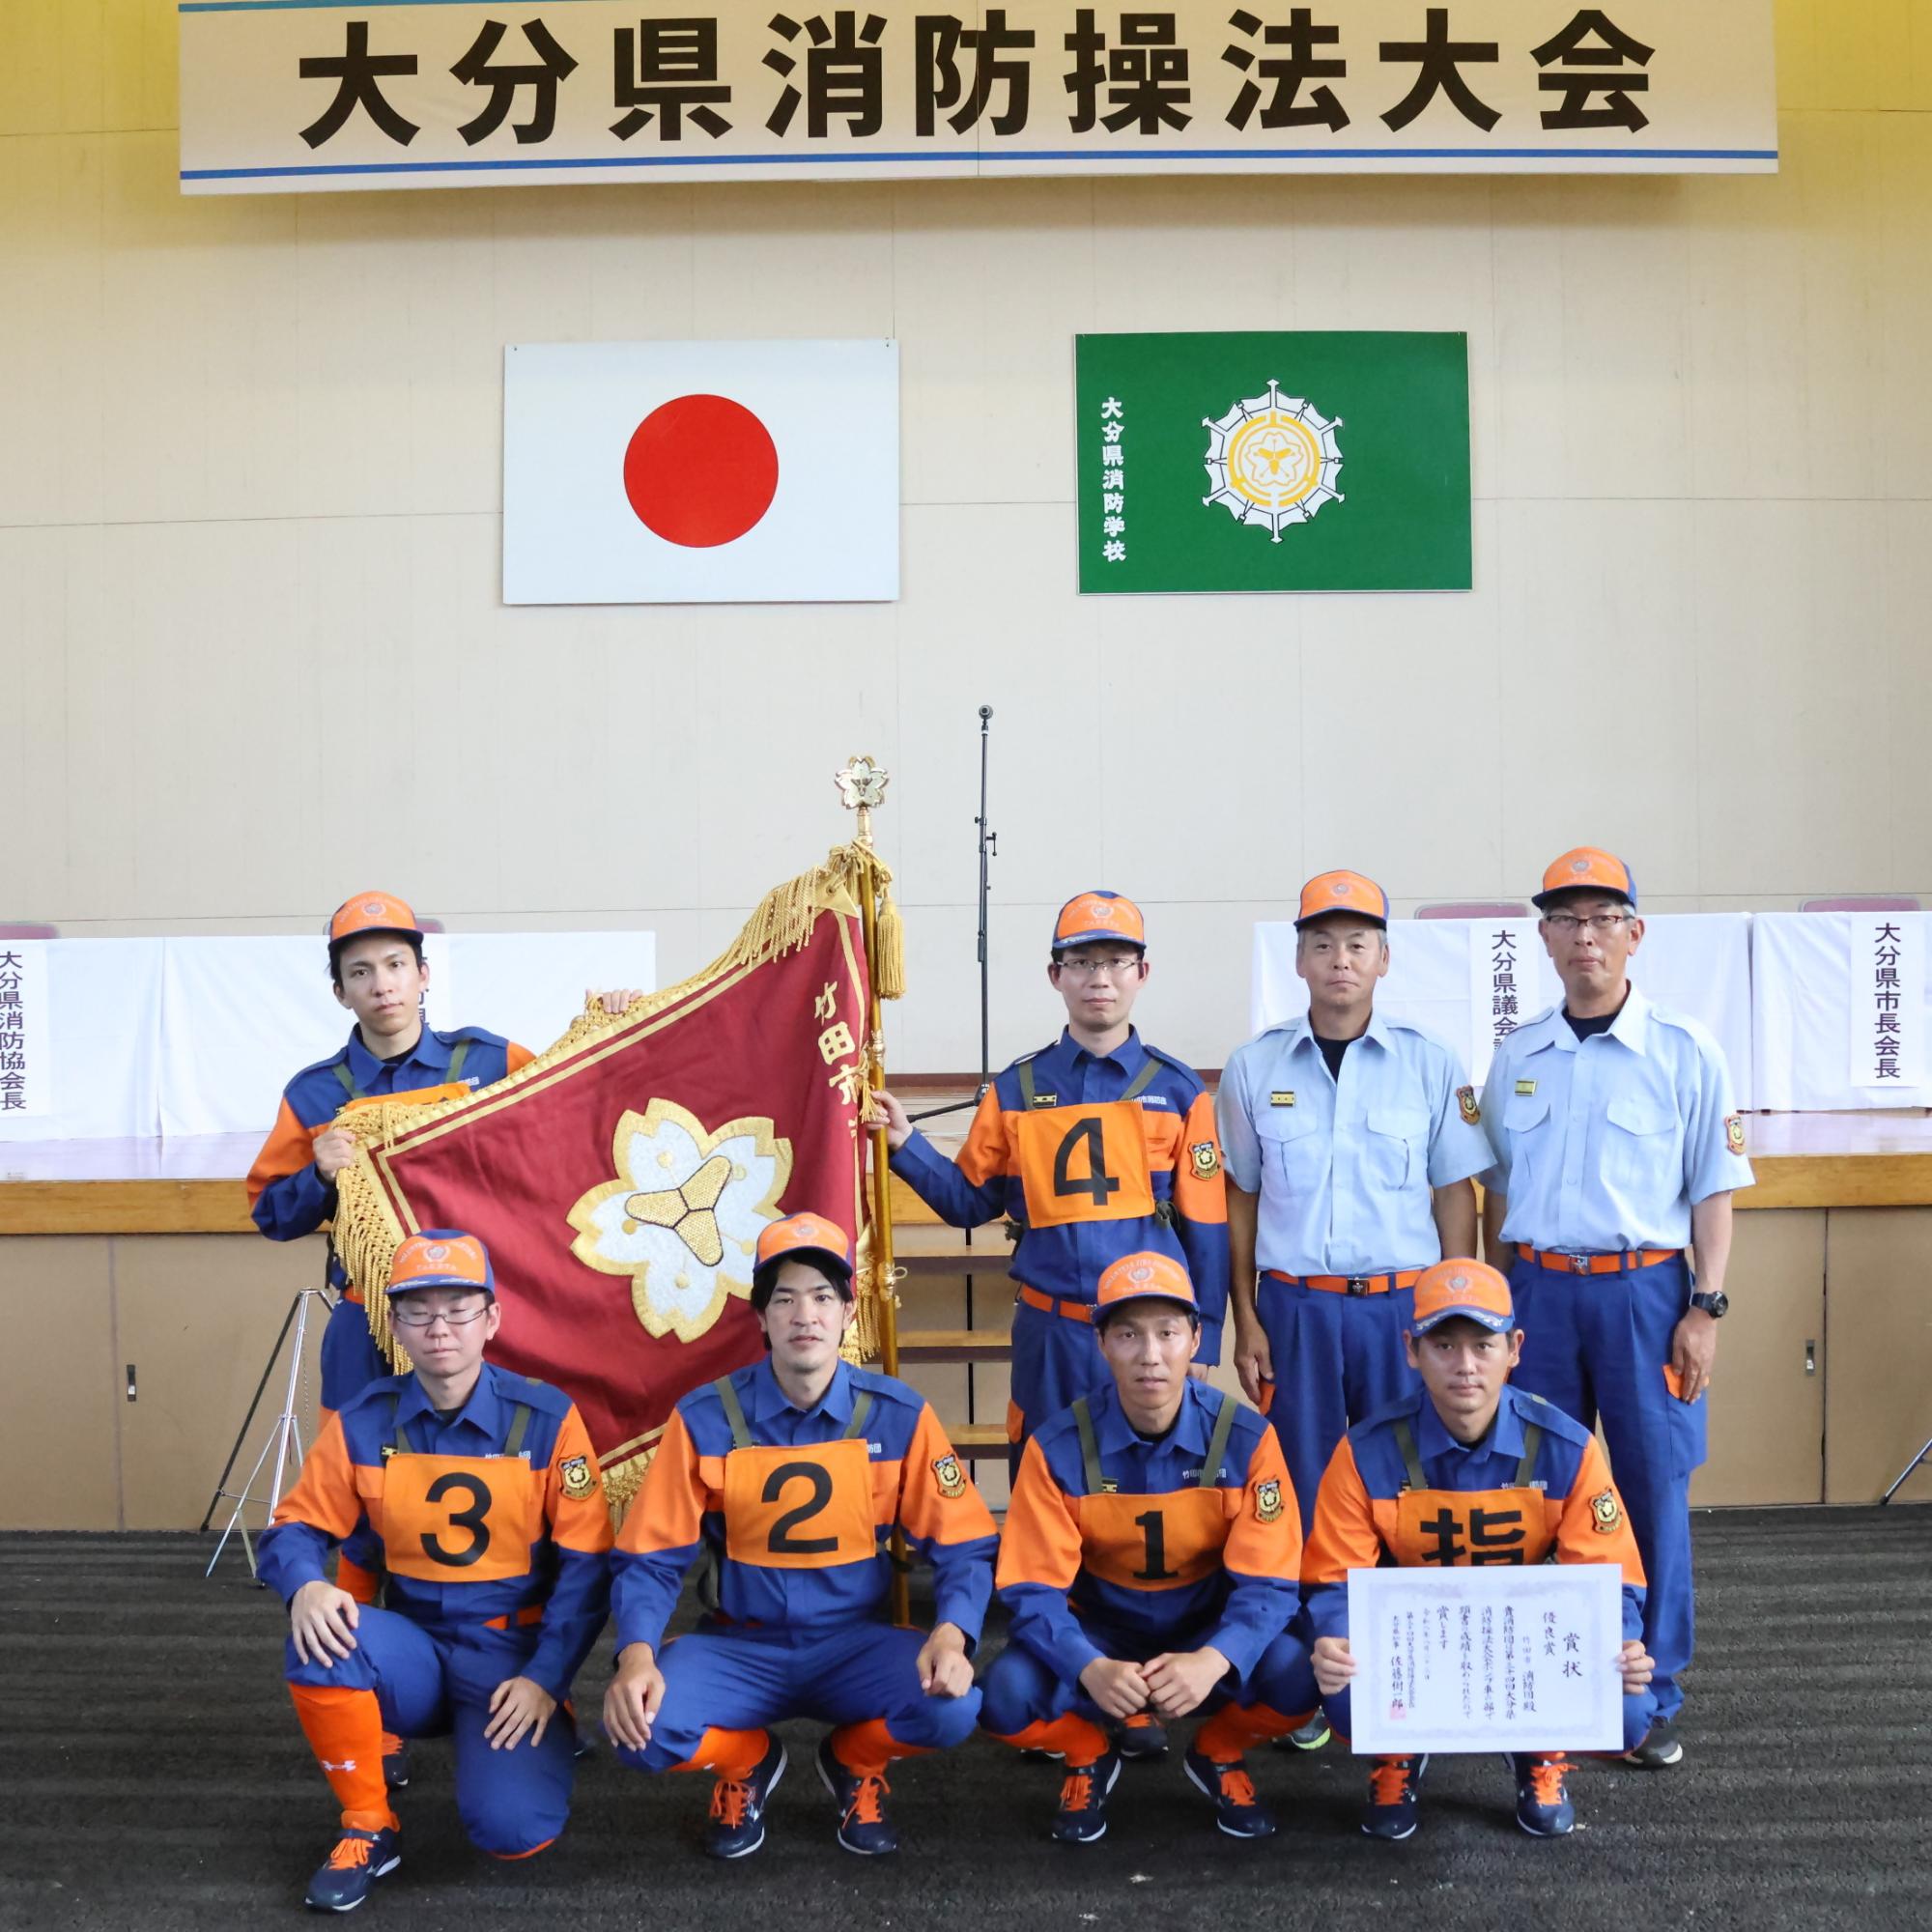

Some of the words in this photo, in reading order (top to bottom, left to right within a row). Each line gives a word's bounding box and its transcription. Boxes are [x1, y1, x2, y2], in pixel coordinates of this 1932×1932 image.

[298, 8, 1657, 151] 大分県消防操法大会
[1101, 396, 1127, 563] 大分県消防学校
[0, 951, 27, 1111] 大分県消防協会長
[1491, 929, 1520, 1050] 大分県議会
[1874, 922, 1901, 1080] 大分県市長会長
[813, 980, 860, 1138] 竹田市
[1053, 1117, 1121, 1207] 4
[420, 1471, 493, 1568] 3
[760, 1461, 839, 1554] 2
[1132, 1509, 1179, 1580] 1
[1543, 1611, 1557, 1657] 優良賞
[1562, 1632, 1583, 1678] 賞状
